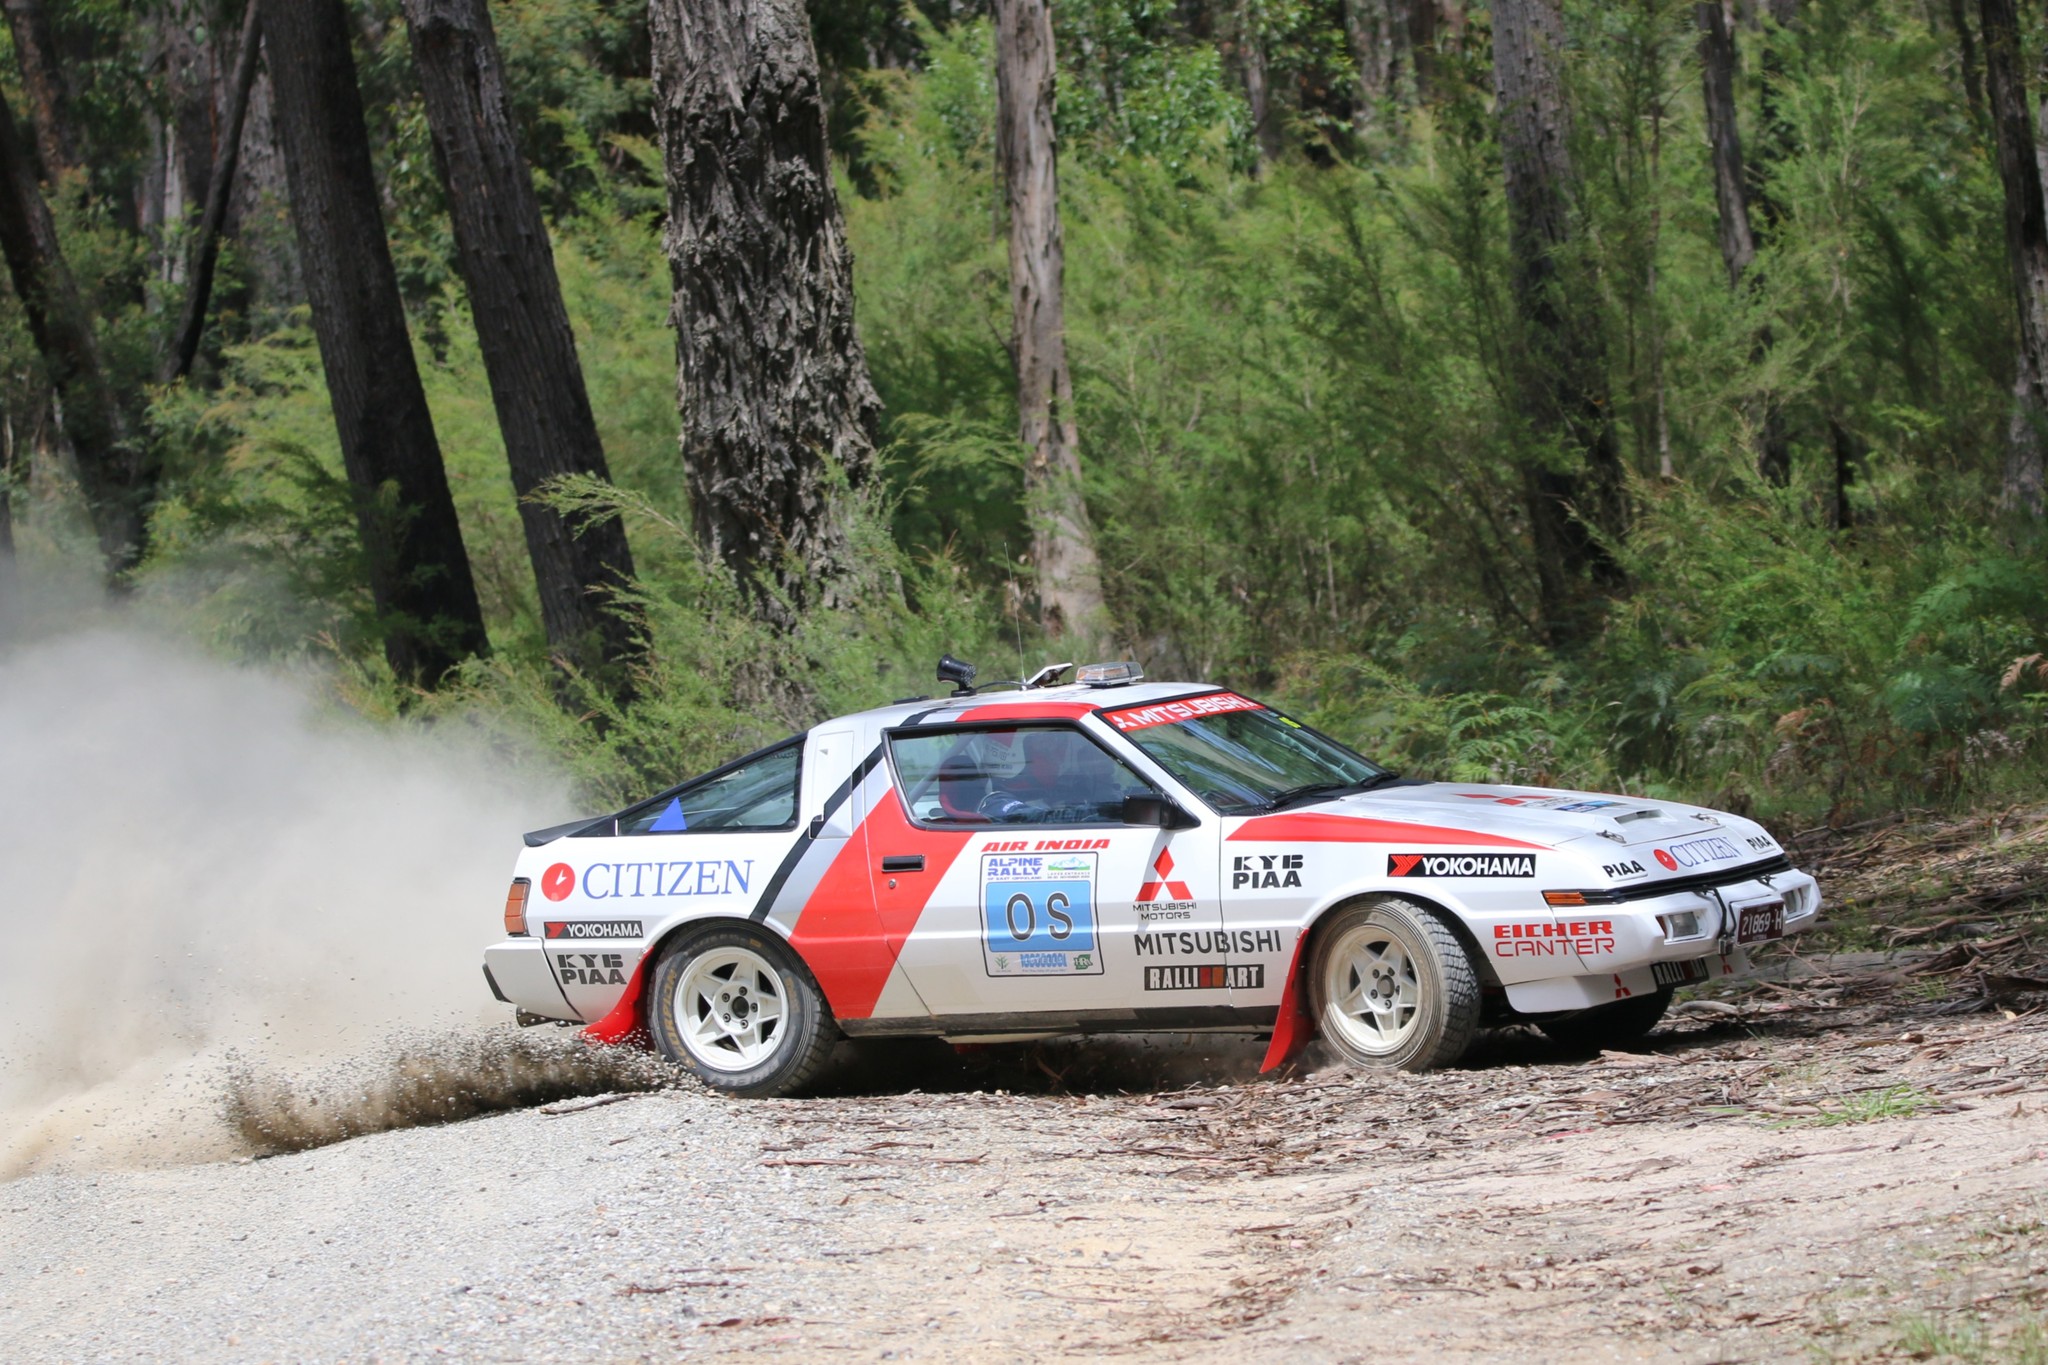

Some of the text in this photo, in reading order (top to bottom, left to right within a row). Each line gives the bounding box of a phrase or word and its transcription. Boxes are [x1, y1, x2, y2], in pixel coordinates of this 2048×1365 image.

[1127, 695, 1249, 725] MITSUBISHI
[981, 838, 1111, 852] AIR INDIA
[1746, 835, 1773, 851] PIAA
[1670, 836, 1742, 868] CITIZEN
[988, 857, 1043, 868] ALPINE
[1233, 854, 1303, 871] KYB
[1421, 857, 1534, 876] YOKOHAMA
[1602, 860, 1646, 878] PIAA
[582, 859, 755, 900] CITIZEN
[987, 867, 1042, 877] RALLY
[1232, 870, 1302, 889] PIAA
[1132, 902, 1197, 912] MITSUBISHI
[1140, 911, 1191, 921] MOTORS
[566, 923, 642, 938] YOKOHAMA
[1493, 920, 1614, 939] EICHER
[1133, 929, 1282, 956] MITSUBISHI
[1495, 937, 1615, 957] CANTER
[556, 953, 624, 969] KYB
[559, 968, 627, 985] PIAA
